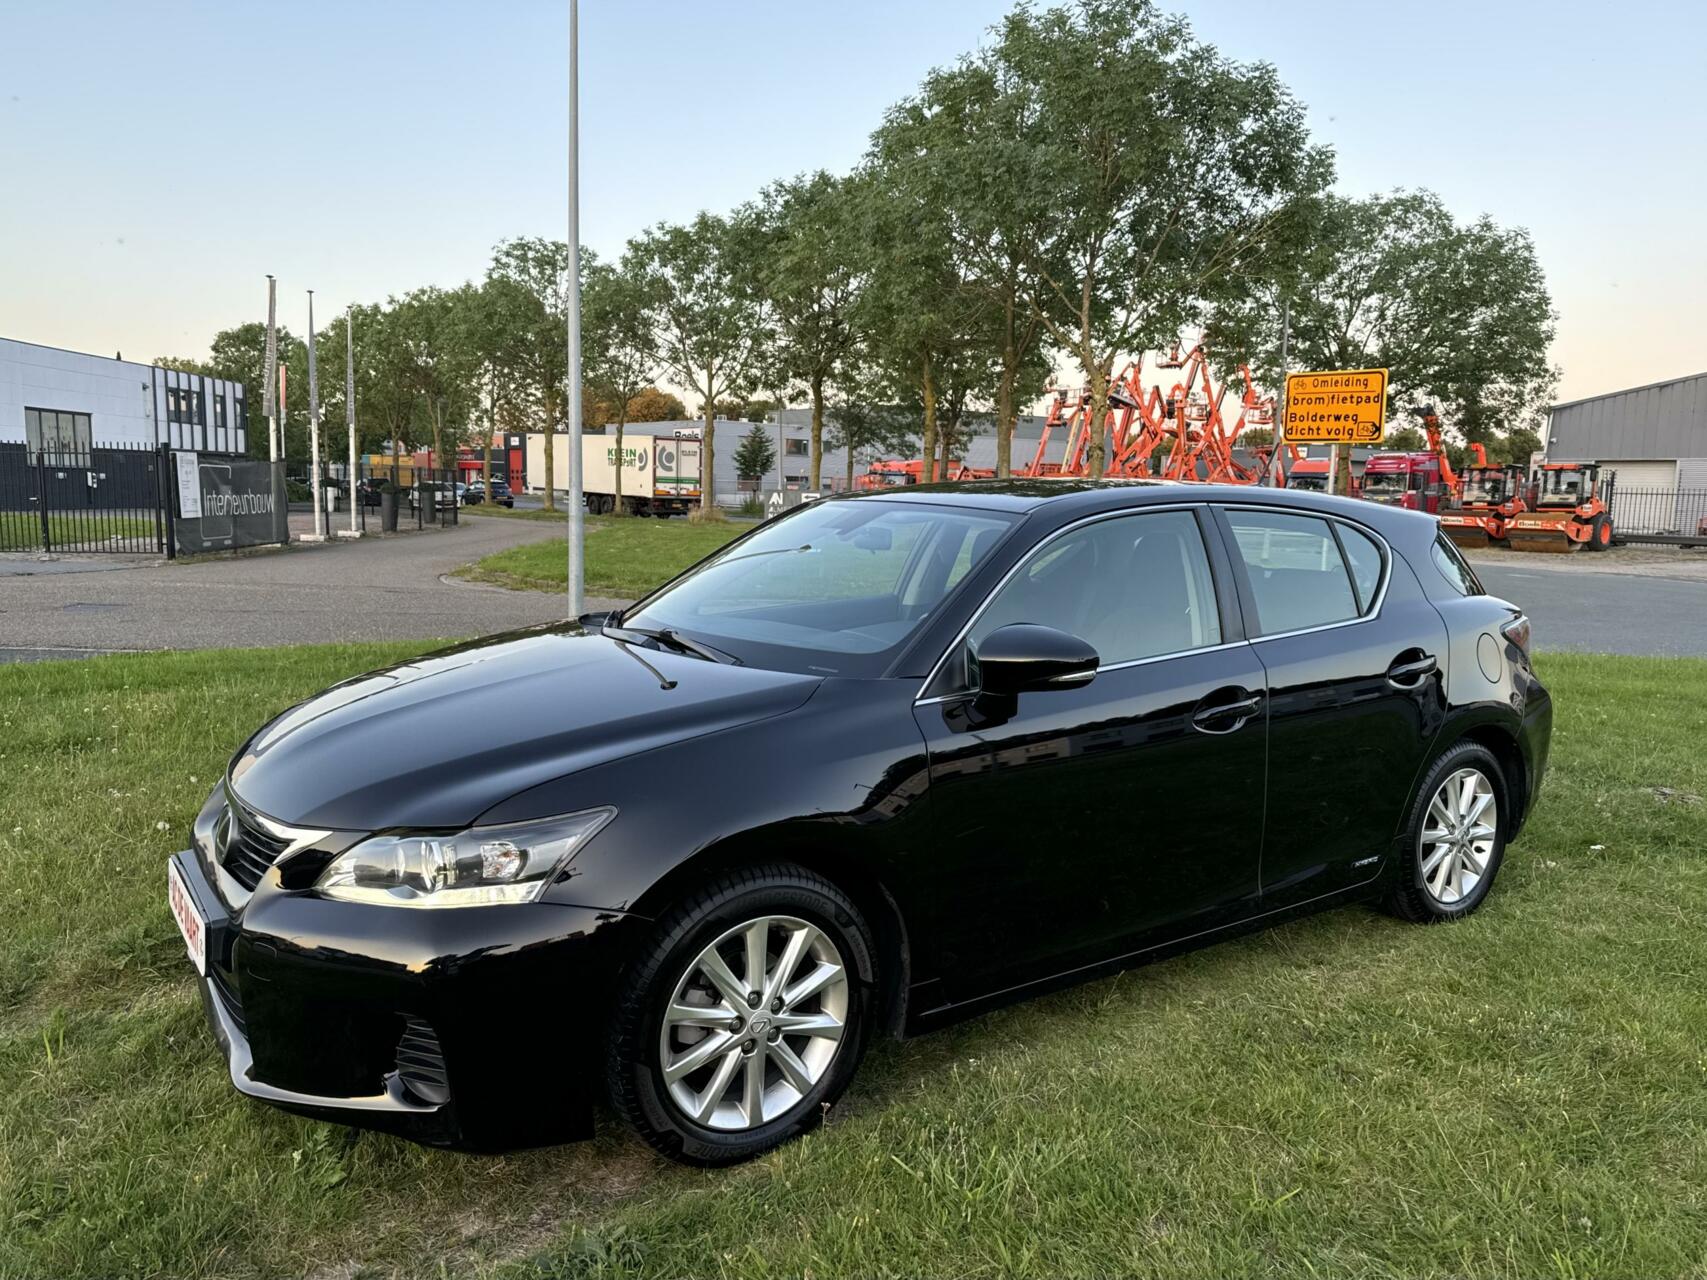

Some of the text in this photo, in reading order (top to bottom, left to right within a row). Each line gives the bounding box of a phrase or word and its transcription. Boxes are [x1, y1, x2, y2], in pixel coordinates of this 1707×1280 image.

[1312, 378, 1369, 389] Omleiding
[1288, 393, 1380, 408] (brom)fietpad
[1289, 412, 1358, 424] Bolderweg
[1286, 426, 1354, 439] dicht volg
[607, 448, 637, 457] KEIN
[203, 487, 275, 516] Interieurbouw
